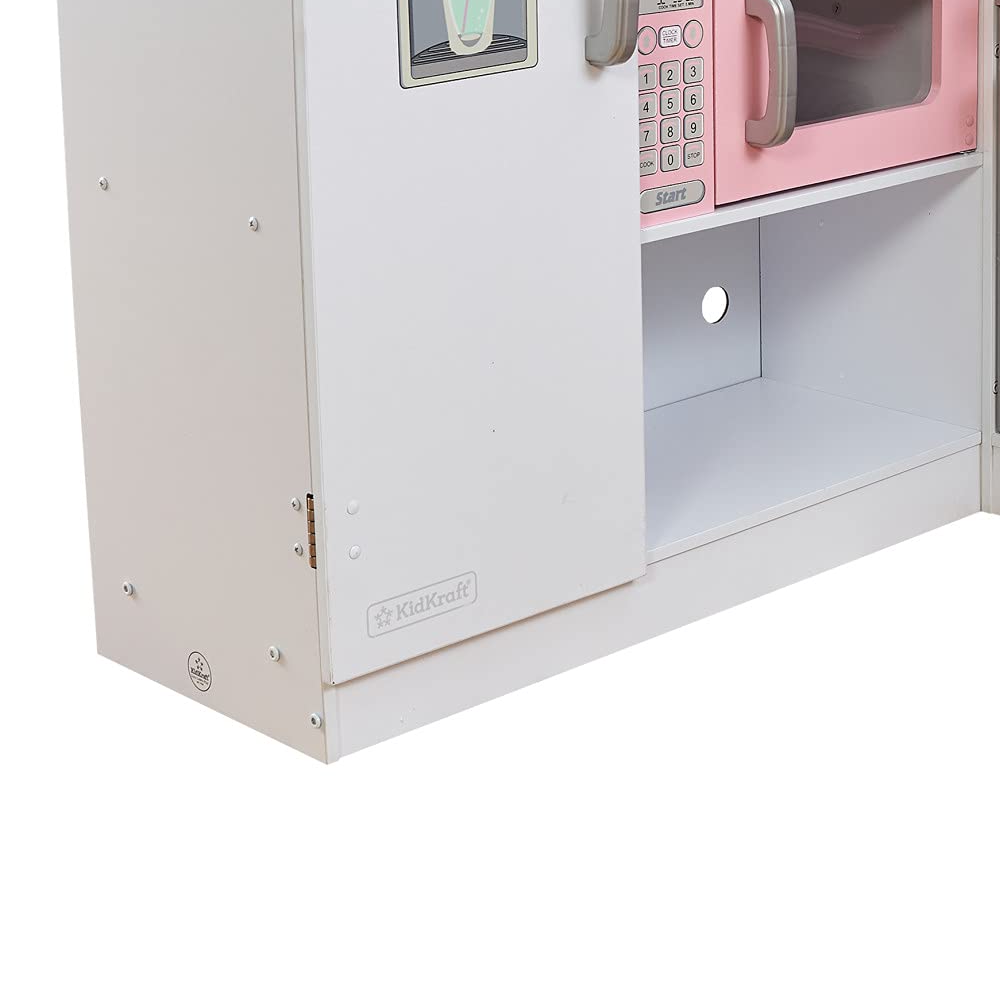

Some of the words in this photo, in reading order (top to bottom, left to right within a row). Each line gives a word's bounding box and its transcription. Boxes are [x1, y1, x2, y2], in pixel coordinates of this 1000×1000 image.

[643, 72, 649, 85] 1
[666, 68, 673, 81] 2
[690, 65, 697, 78] 3
[642, 101, 650, 113] 4
[667, 97, 674, 110] 5
[690, 93, 697, 106] 6
[643, 129, 650, 142] 7
[667, 126, 674, 138] 8
[690, 121, 697, 134] 9
[667, 153, 674, 166] 0
[687, 152, 700, 161] STOP
[655, 187, 687, 206] Start
